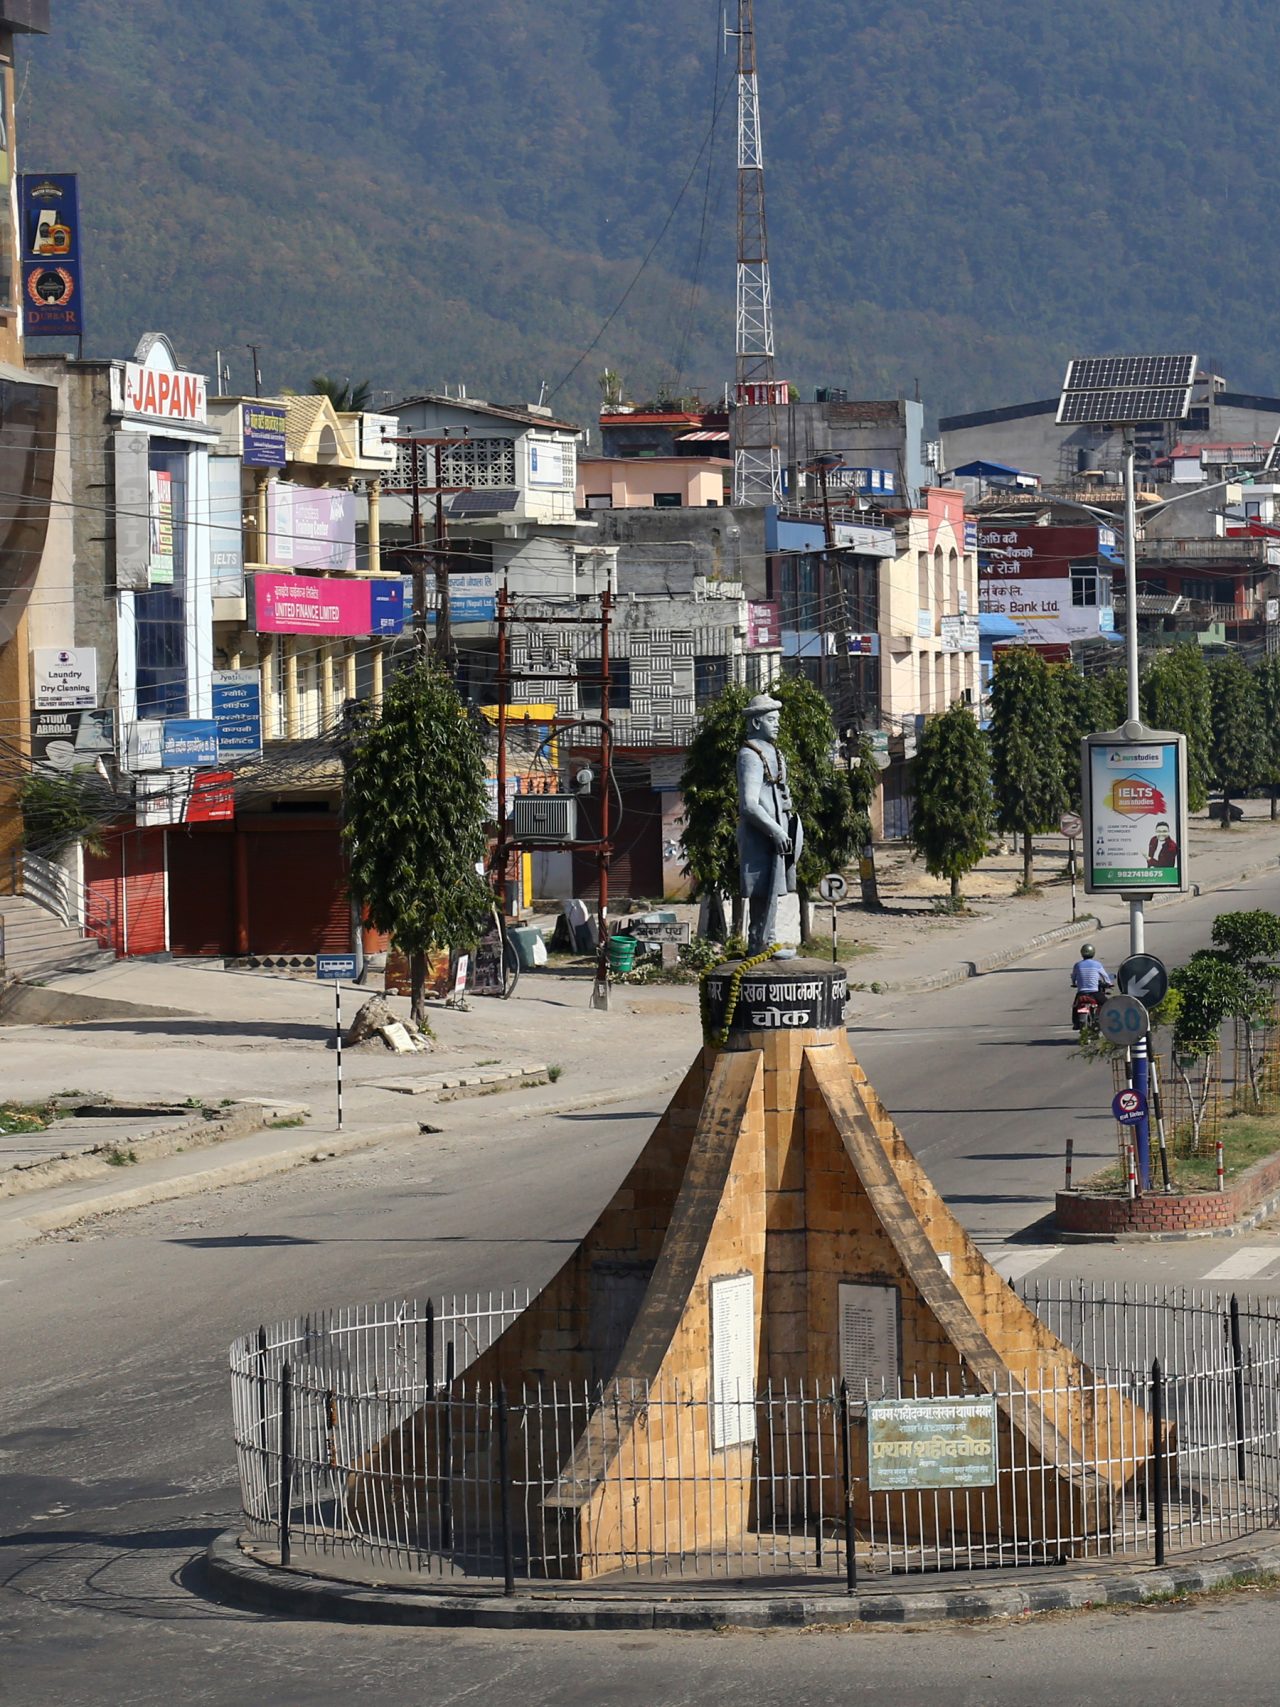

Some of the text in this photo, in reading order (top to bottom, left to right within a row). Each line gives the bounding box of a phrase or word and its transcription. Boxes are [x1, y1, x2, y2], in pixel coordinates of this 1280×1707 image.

[133, 368, 197, 418] JAPAN
[213, 553, 237, 564] IELTS
[275, 603, 339, 620] UNITED FINANCE LIMITED
[1010, 601, 1038, 612] Bank
[1042, 600, 1060, 612] Ltd.
[48, 671, 82, 679] Laundry
[41, 685, 55, 693] Dry
[39, 714, 67, 723] STUDY
[36, 724, 71, 734] ABROAD
[1119, 788, 1153, 797] IELTS
[828, 878, 843, 897] P
[740, 983, 767, 1002] खन
[797, 981, 823, 1001] मगर
[751, 1006, 811, 1027] चोक
[1106, 1008, 1140, 1032] 30
[871, 1408, 894, 1421] प्रथम
[872, 1435, 991, 1459] प्रथम शहीद चोक
